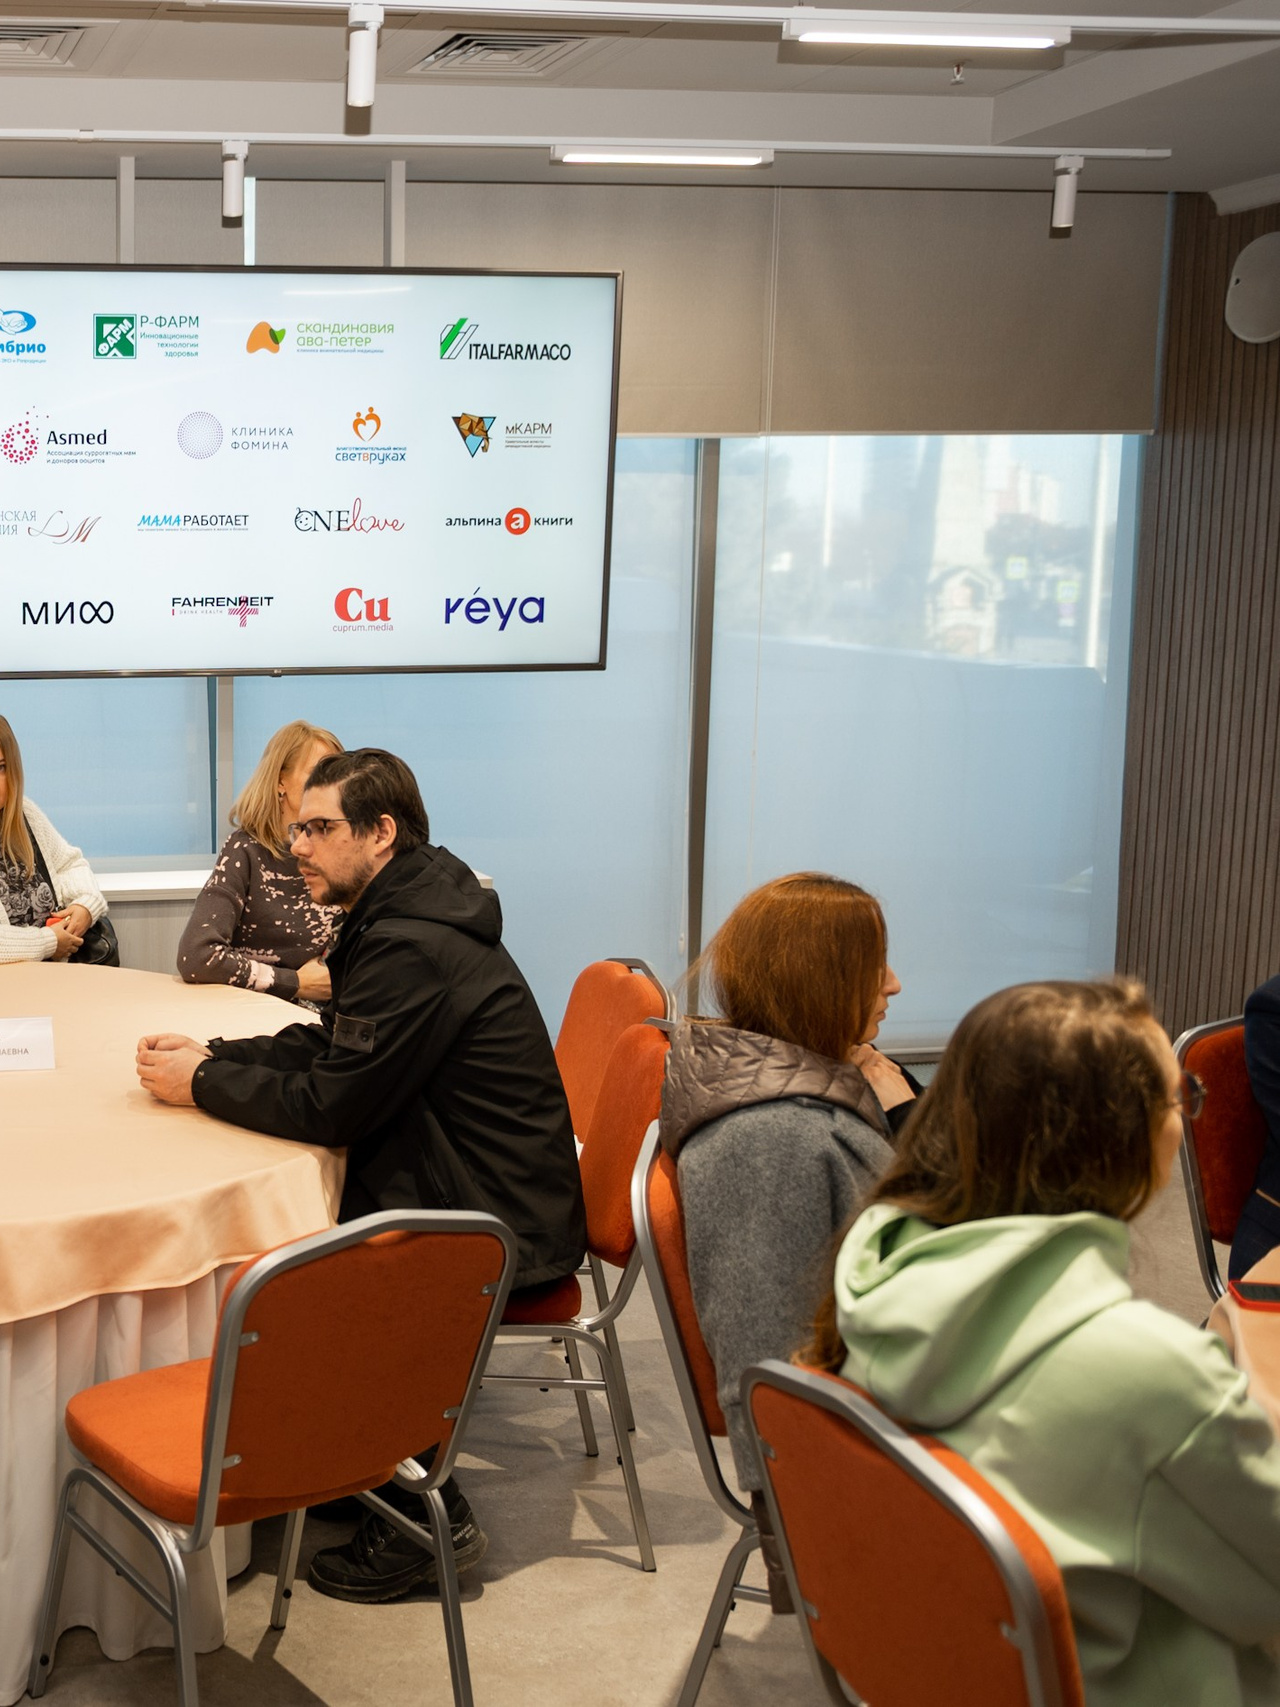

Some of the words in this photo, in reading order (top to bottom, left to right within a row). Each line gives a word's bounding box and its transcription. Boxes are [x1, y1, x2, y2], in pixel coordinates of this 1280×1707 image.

[140, 315, 200, 328] Р-ФАРМ
[140, 332, 199, 340] Инновационные
[468, 343, 572, 361] ITALFARMACO
[46, 429, 107, 445] Asmed
[231, 427, 293, 436] КЛИНИКА
[230, 441, 289, 450] ФОМИНА
[137, 514, 181, 527] МАМА
[183, 514, 249, 526] РАБОТАЕТ
[445, 517, 502, 527] альпина
[534, 517, 573, 526] книги
[172, 596, 274, 607] FAHRENHEIT
[334, 587, 391, 622] Cu
[444, 586, 545, 631] réya
[332, 623, 394, 633] cuprum.media
